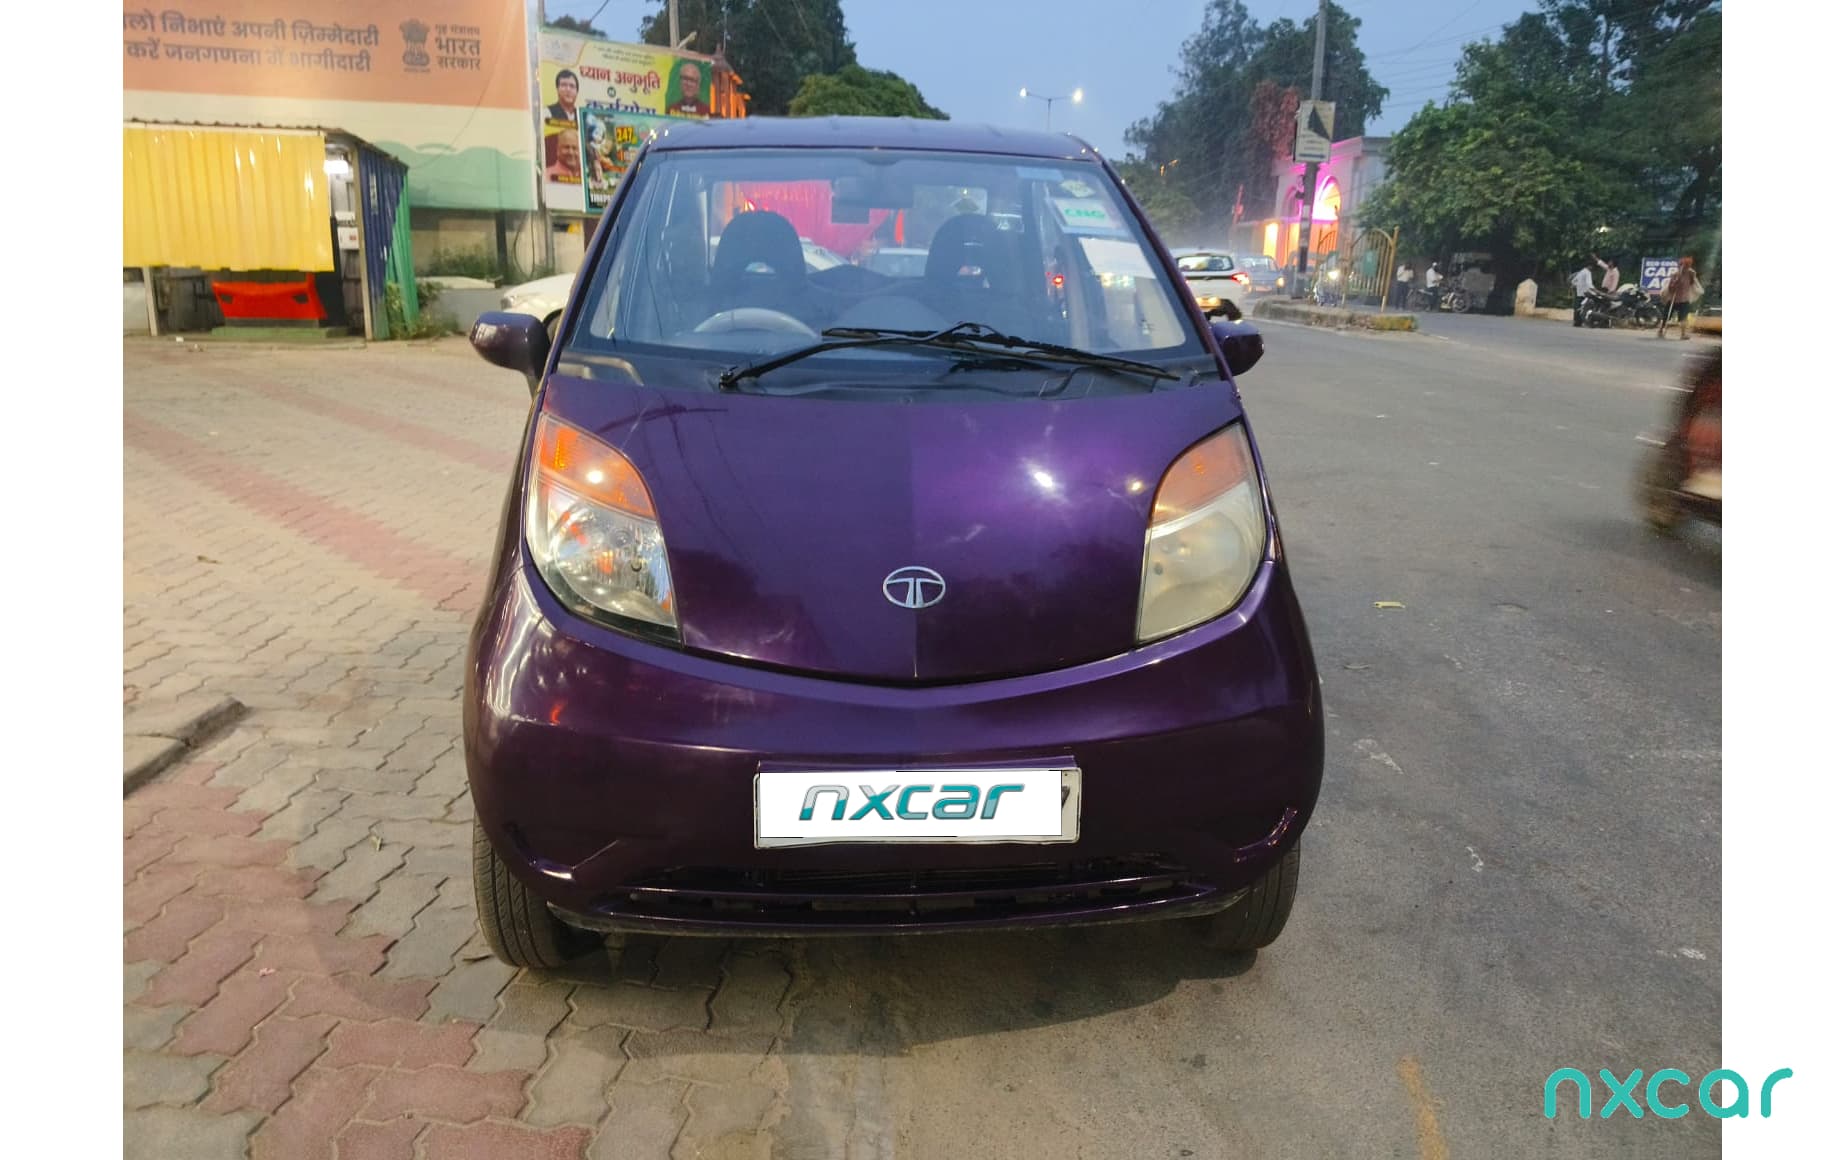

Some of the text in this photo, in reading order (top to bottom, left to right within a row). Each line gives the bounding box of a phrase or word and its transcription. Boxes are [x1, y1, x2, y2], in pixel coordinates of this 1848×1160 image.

[161, 10, 226, 36] निभाएं
[232, 18, 286, 40] अपनी
[124, 37, 160, 59] करें
[162, 43, 261, 64] जनगणना
[289, 48, 371, 71] भागीदारी
[435, 37, 481, 56] भारत
[436, 56, 481, 70] सरकार
[579, 66, 611, 82] ध्यान
[615, 70, 660, 95] अनुभूति
